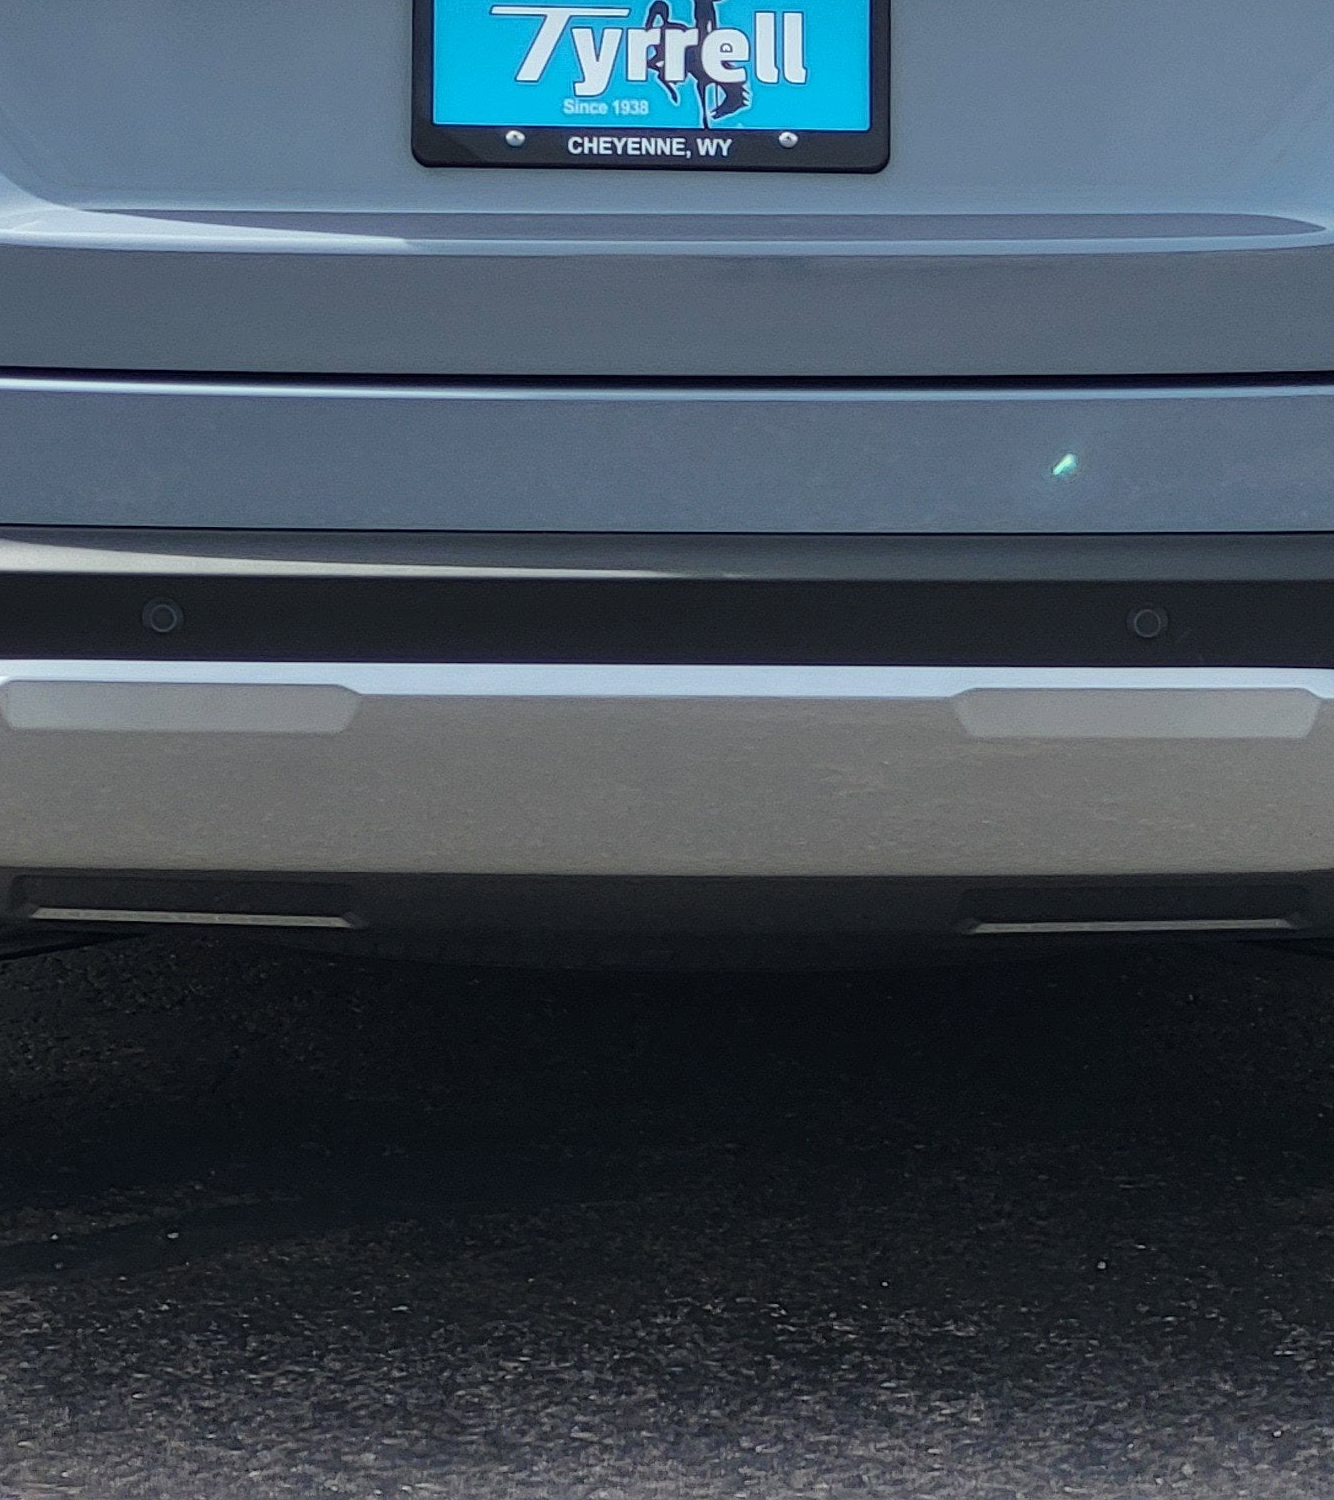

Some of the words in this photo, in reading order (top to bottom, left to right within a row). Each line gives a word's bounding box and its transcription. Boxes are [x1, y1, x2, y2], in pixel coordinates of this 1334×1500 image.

[490, 4, 808, 98] Tyrrell
[563, 98, 608, 116] Since
[612, 99, 649, 117] 1938
[567, 136, 692, 160] CHEYENNE,
[697, 138, 733, 157] WY
